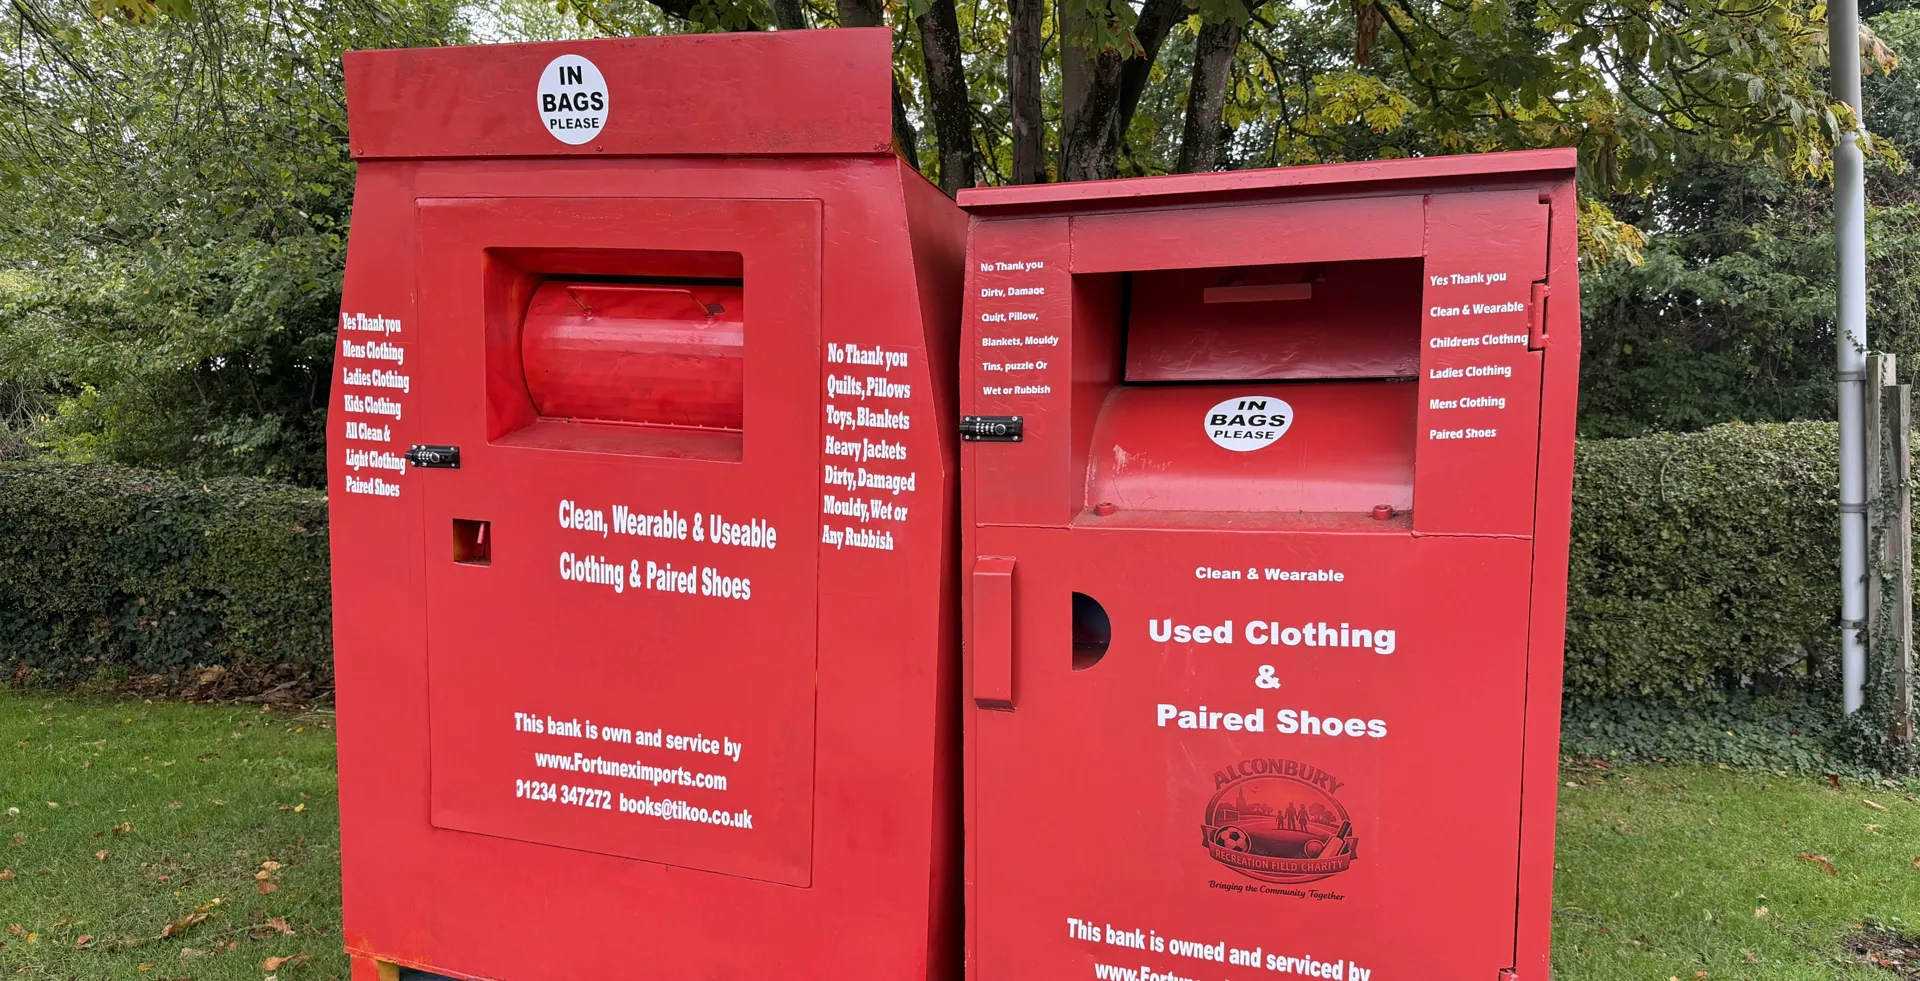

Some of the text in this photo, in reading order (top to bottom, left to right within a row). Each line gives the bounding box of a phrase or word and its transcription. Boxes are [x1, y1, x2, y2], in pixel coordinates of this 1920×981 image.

[559, 66, 582, 85] IN
[543, 92, 604, 112] BAGS
[550, 118, 599, 129] PLEASE
[981, 261, 1043, 272] No Thank you
[1430, 272, 1506, 286] Yes Thank you
[1009, 312, 1039, 321] Pillow,
[1430, 302, 1524, 317] Clean & Wearable
[342, 312, 401, 336] Yes Thank you
[343, 340, 404, 365] Mens Clothing
[982, 336, 1058, 347] Blankets, Mouldy
[1430, 334, 1528, 348] Childrens Clothing
[828, 343, 908, 371] No Thank you
[983, 361, 1047, 372] Tins, puzzle Or
[343, 367, 409, 393] Ladies Clothing
[1430, 365, 1512, 379] Ladies Clothing
[828, 374, 911, 400] Quilts, Pillows
[983, 385, 1051, 395] Wet or Rubbish
[344, 395, 401, 420] Kids Clothing
[1238, 401, 1267, 410] IN
[1430, 396, 1505, 409] Mens Clothing
[827, 405, 910, 430] Toys, Blankets
[1210, 414, 1286, 427] BAGS
[346, 422, 391, 442] All Clean &
[1214, 430, 1275, 439] PLEASE
[1430, 428, 1496, 440] Paired Shoes
[825, 435, 907, 462] Heavy Jackets
[346, 449, 406, 475] Light Clothing
[346, 476, 400, 497] Paired Shoes
[825, 465, 915, 495] Dirty, Damaged
[824, 495, 908, 522] Mouldy, Wet or
[559, 500, 776, 549] Clean, Wearable & Useable
[822, 525, 894, 550] Any Rubbish
[560, 552, 750, 600] Clothing & Paired Shoes
[1195, 567, 1344, 582] Clean & Wearable
[1150, 619, 1396, 654] Used Clothing
[1255, 665, 1281, 689] &
[1157, 704, 1387, 738] Paired Shoes
[515, 712, 741, 762] This bank is own and service by
[535, 753, 727, 790] www.Fortuneximports.com
[1213, 758, 1344, 794] ALCONBURY
[516, 779, 752, 829] 01234 347272 books@tikoo.co.uk
[1215, 849, 1343, 871] RECREATION FIELD CHARITY
[1208, 880, 1345, 901] Bringing the Community Together
[1067, 918, 1371, 981] This bank is owned and serviced by
